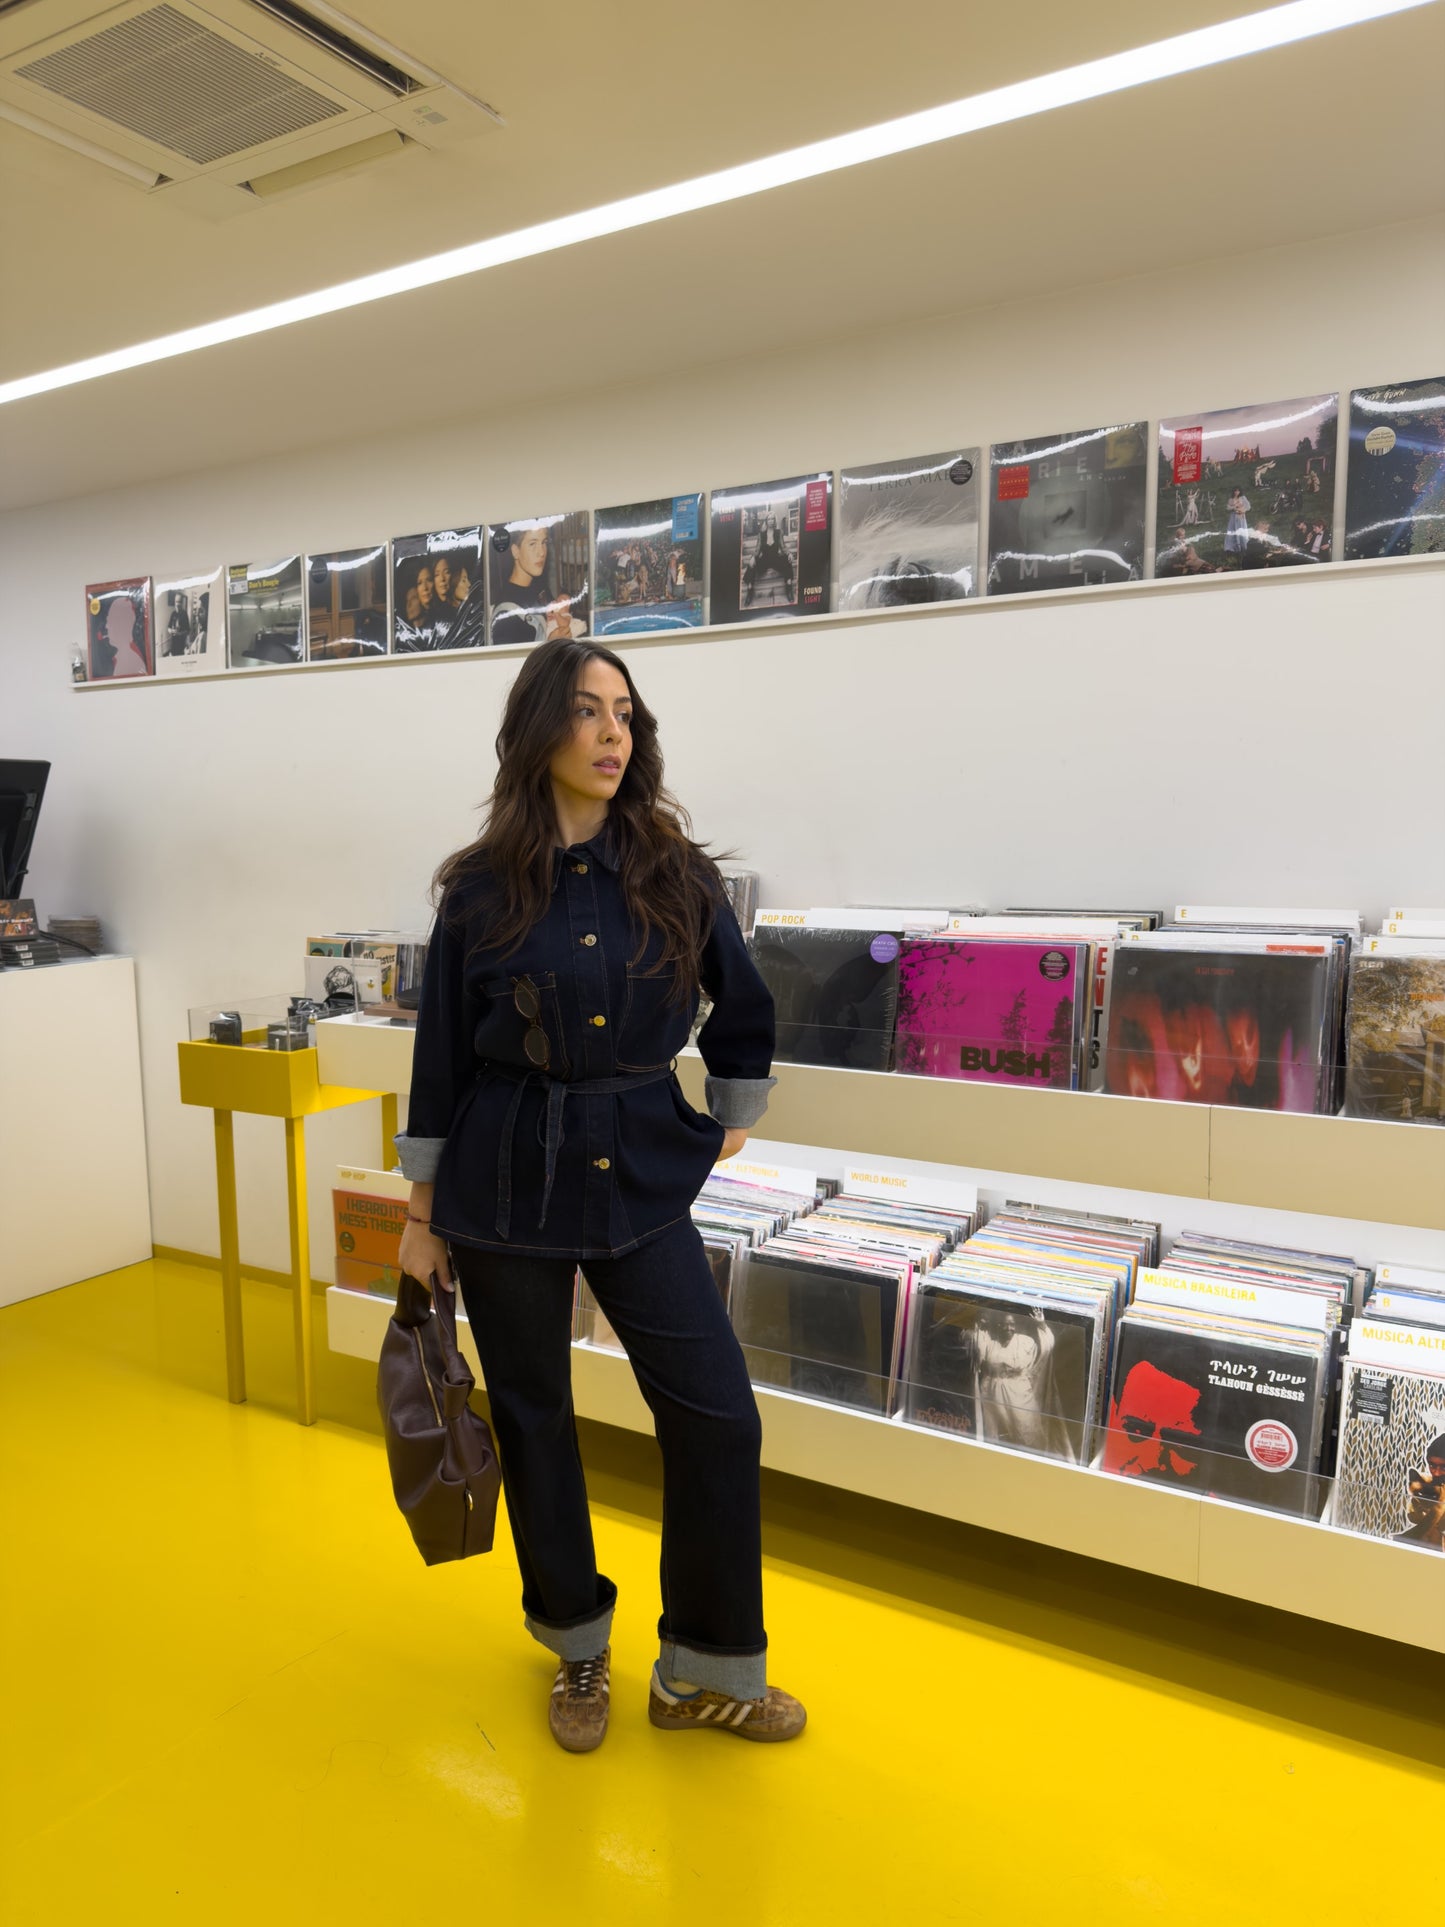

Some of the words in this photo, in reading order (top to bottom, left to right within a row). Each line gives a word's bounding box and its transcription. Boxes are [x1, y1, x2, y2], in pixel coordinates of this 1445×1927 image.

[803, 586, 823, 596] FOUND
[1181, 909, 1187, 918] E
[1395, 911, 1403, 920] H
[761, 915, 779, 923] POP
[781, 916, 805, 924] ROCK
[953, 920, 960, 928] C
[1389, 923, 1397, 933] G
[1371, 941, 1378, 952] F
[960, 1046, 1050, 1078] BUSH
[851, 1172, 879, 1184] WORLD
[881, 1176, 908, 1188] MUSIC
[351, 1199, 388, 1217] HEARD
[338, 1211, 367, 1228] MESS
[367, 1217, 405, 1236] THERE
[1382, 1268, 1389, 1278] C
[1143, 1273, 1187, 1291] MUSICA
[1190, 1281, 1257, 1302] BRASILEIRA
[1383, 1297, 1390, 1307] B
[1362, 1327, 1414, 1345] MUSICA
[1208, 1374, 1254, 1392] TLAHOUN
